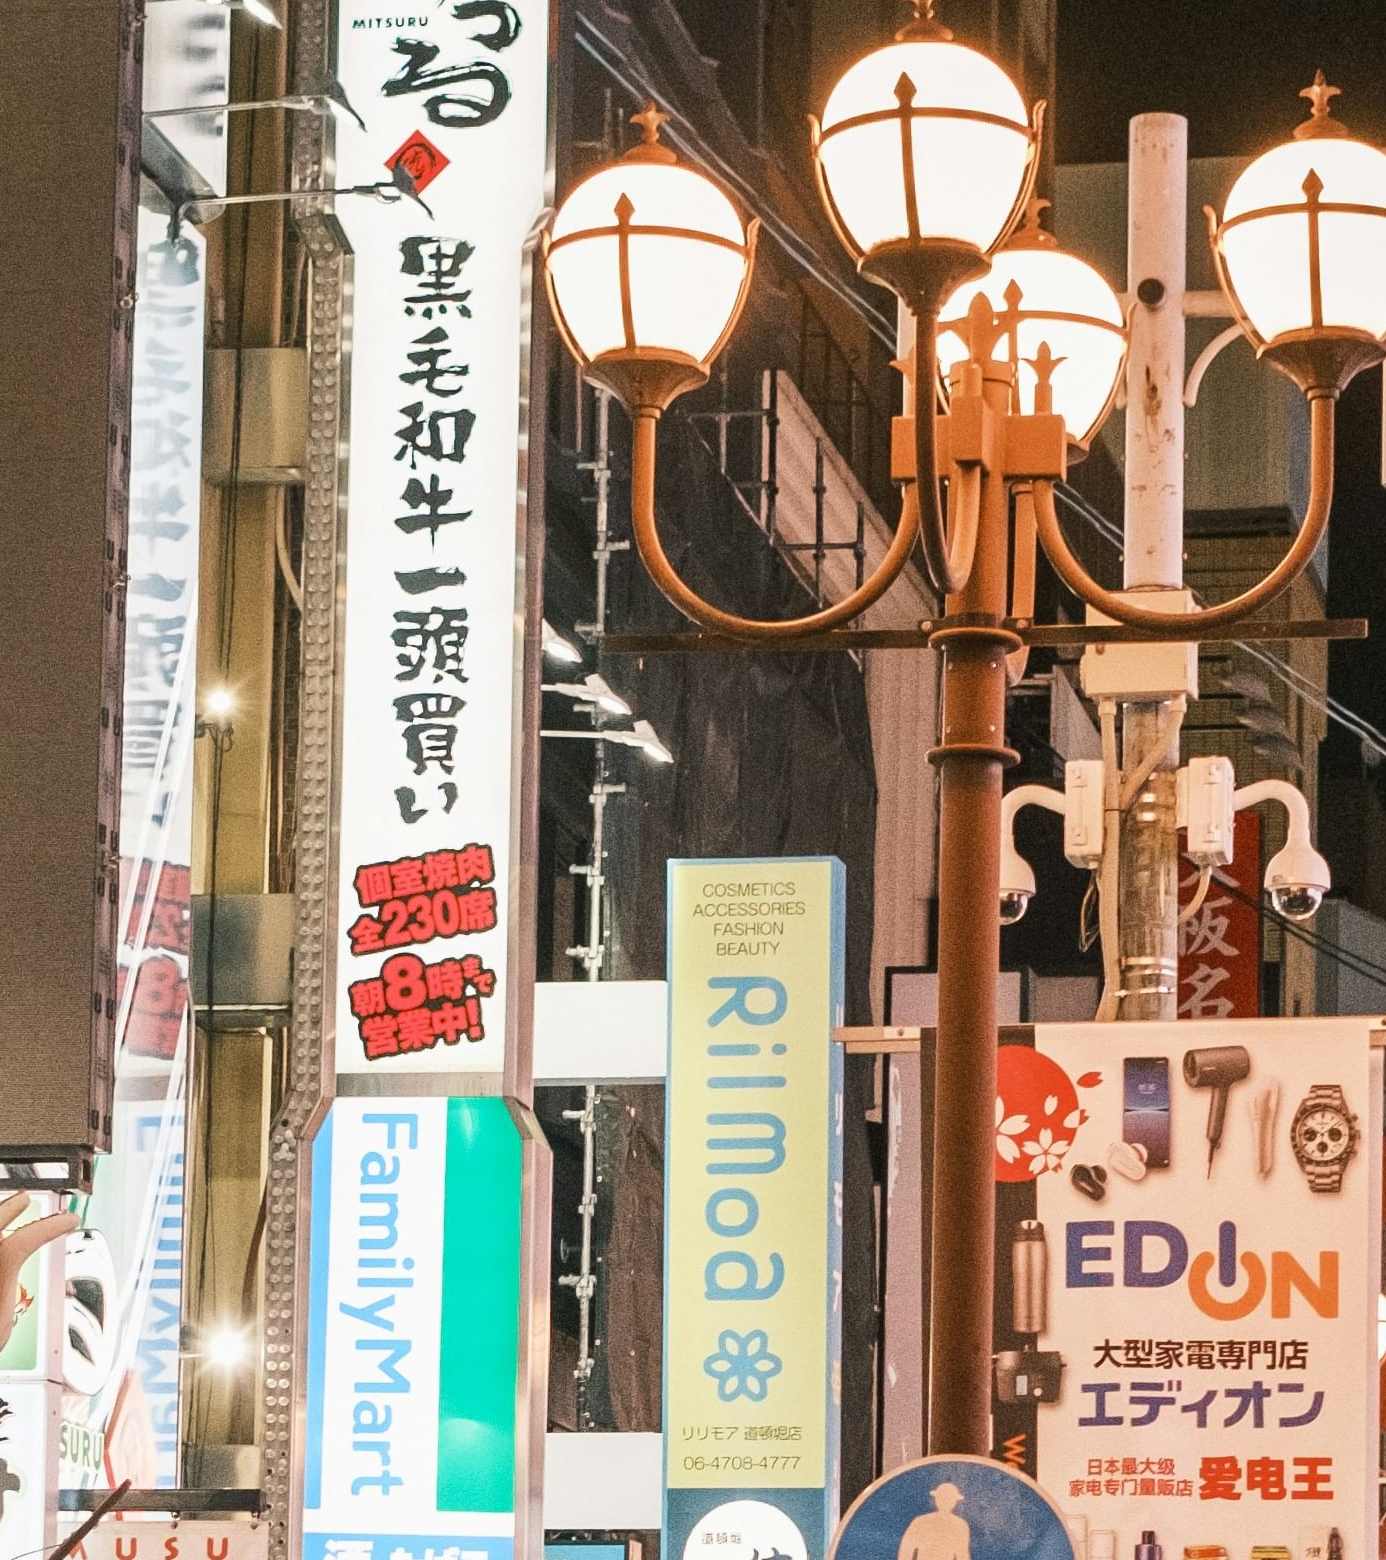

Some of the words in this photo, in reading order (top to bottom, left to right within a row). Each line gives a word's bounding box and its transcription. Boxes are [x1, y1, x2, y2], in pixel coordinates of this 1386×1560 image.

[351, 14, 430, 30] MITSURU
[394, 236, 478, 826] 黒毛和牛一頭買い
[354, 843, 495, 907] 個室焼肉
[701, 883, 797, 898] COSMETICS
[347, 887, 498, 956] 全230席
[691, 901, 807, 917] ACCESSORIES
[712, 921, 786, 937] FASHION
[715, 940, 781, 958] BEAUTY
[348, 952, 497, 1017] 朝8時まで
[1064, 1220, 1340, 1321] EDION
[339, 1113, 419, 1497] FamilyMart
[1093, 1339, 1309, 1371] 大型家電専門店
[1077, 1379, 1325, 1429] エディオン
[683, 1455, 801, 1471] 06-4708-4777
[1199, 1455, 1334, 1501] 爱电王
